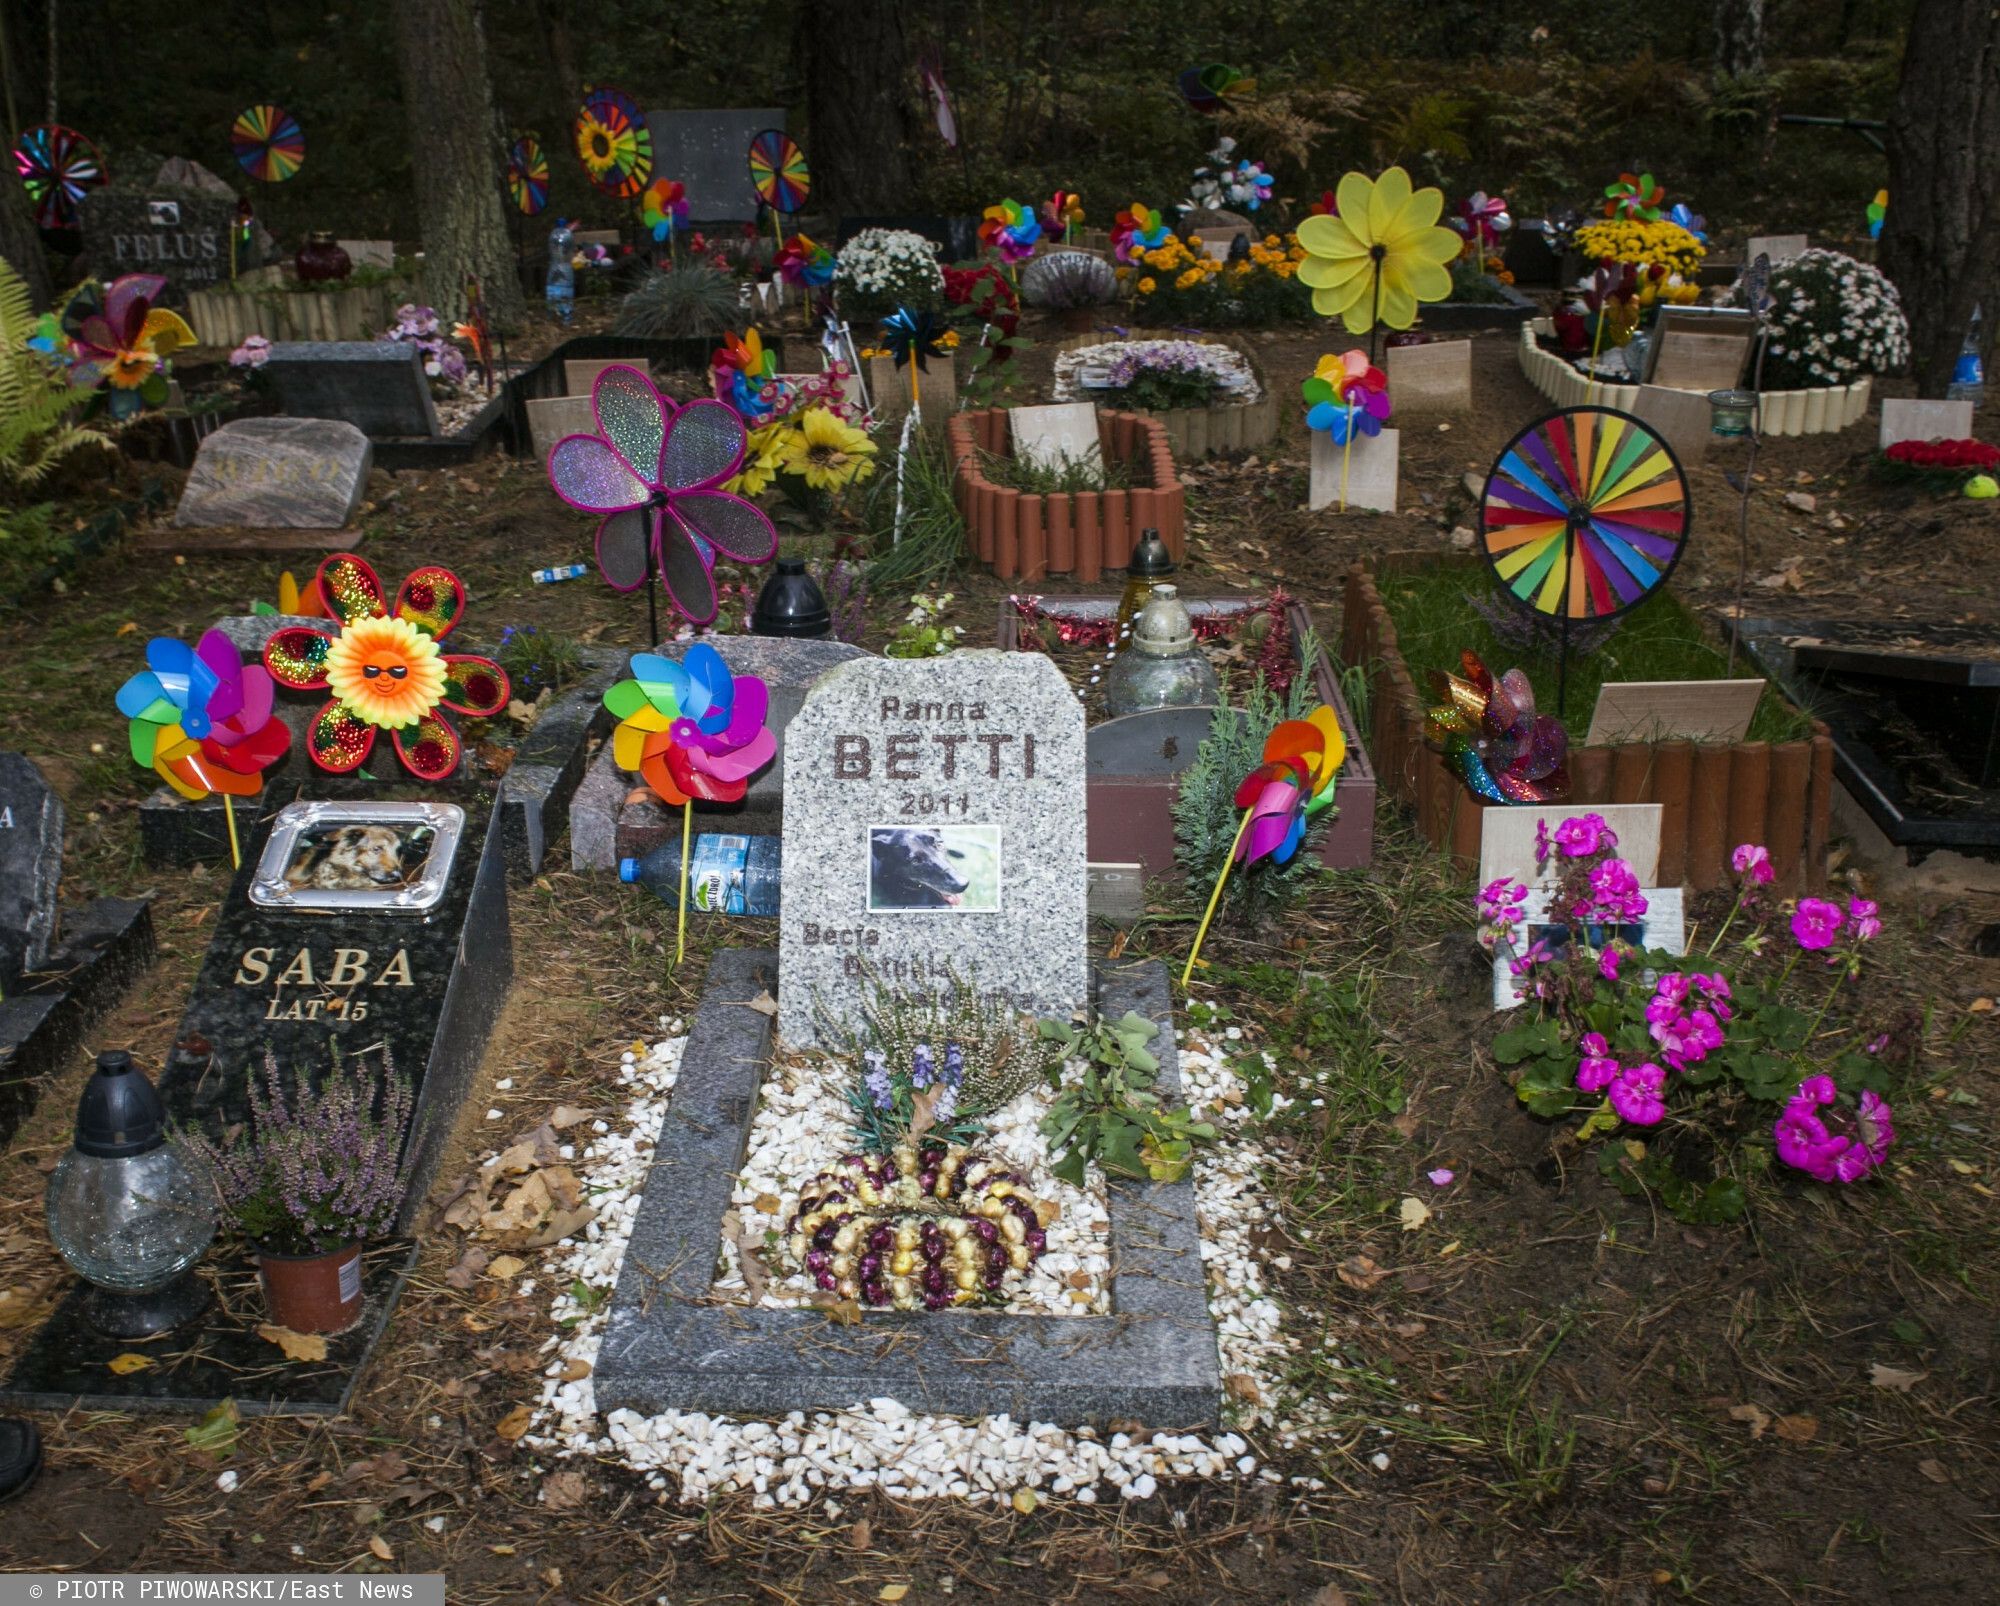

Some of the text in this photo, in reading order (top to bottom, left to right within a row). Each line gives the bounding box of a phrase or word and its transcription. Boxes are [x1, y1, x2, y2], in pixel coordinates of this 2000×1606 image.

[881, 695, 987, 721] Panna
[833, 733, 1035, 780] BETTI
[899, 792, 970, 815] 2011
[802, 922, 880, 946] Becia
[234, 947, 415, 986] SABA
[264, 999, 369, 1021] LAT 15
